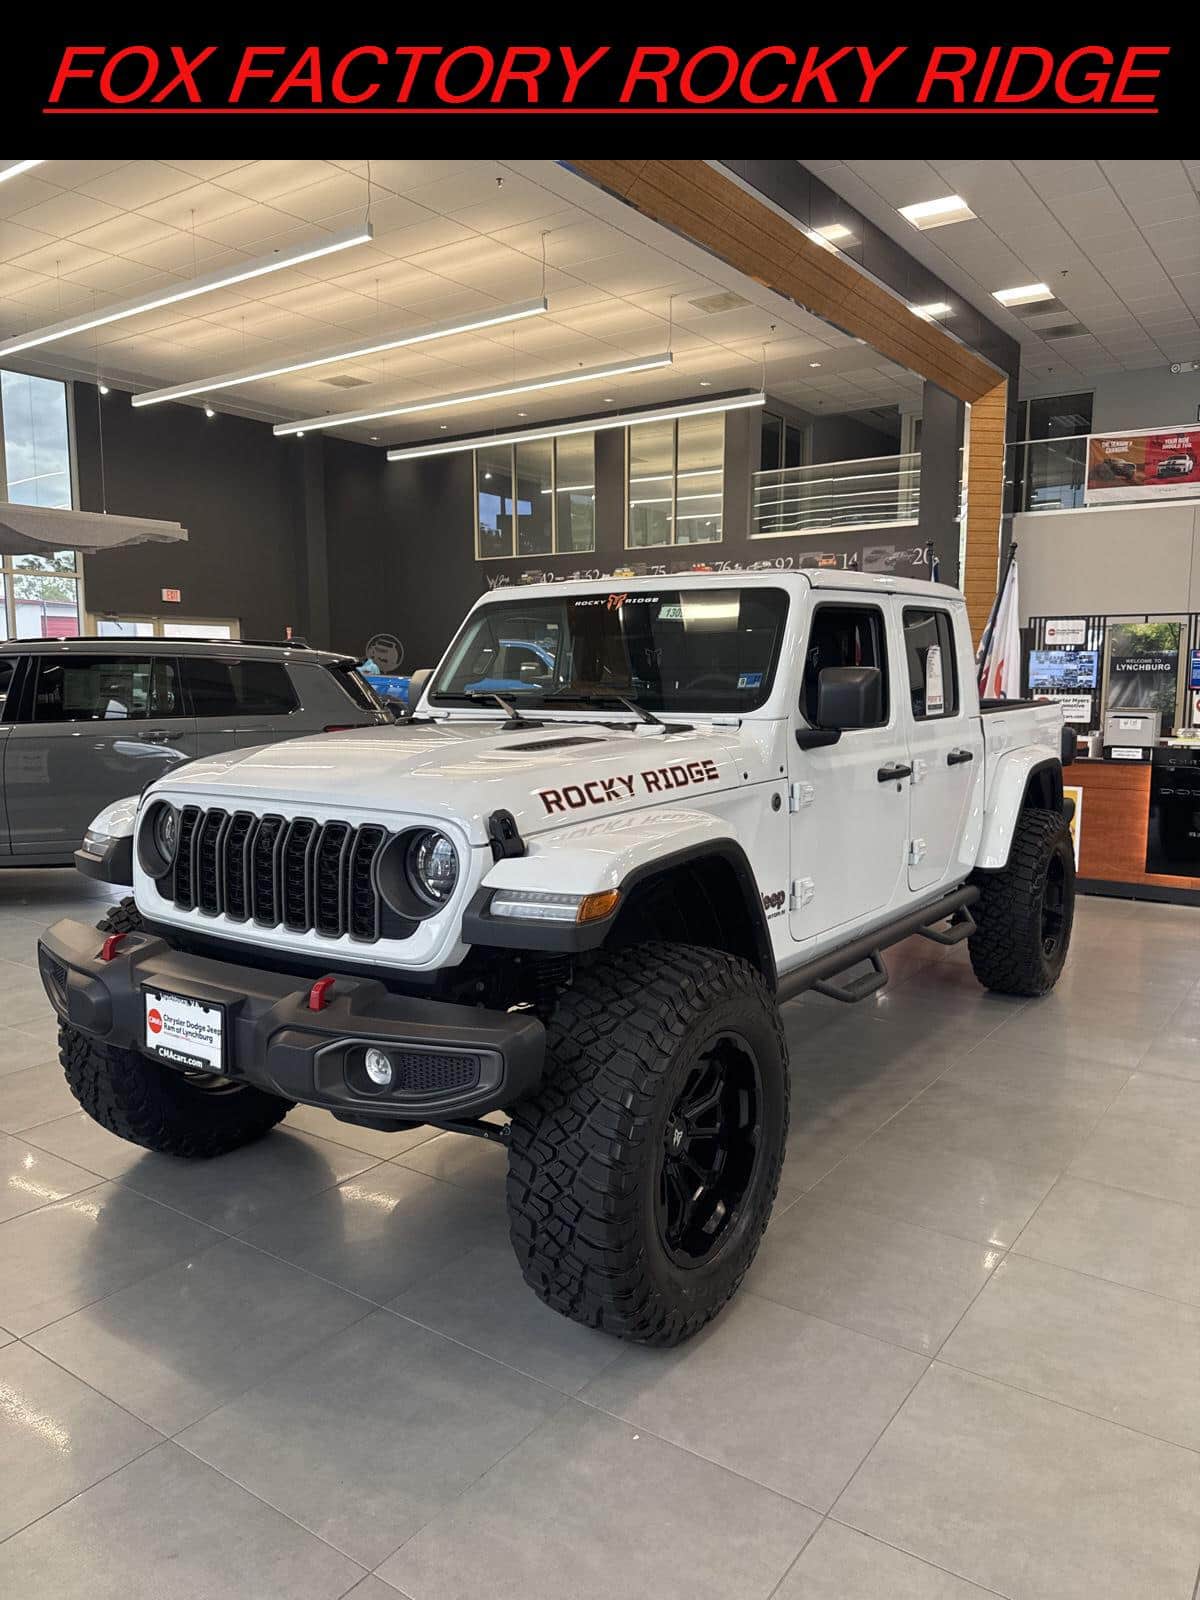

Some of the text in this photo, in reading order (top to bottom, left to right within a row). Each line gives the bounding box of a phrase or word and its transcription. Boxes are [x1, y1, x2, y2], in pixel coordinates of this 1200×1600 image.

[539, 759, 720, 814] ROCKY RIDGE
[163, 1014, 222, 1036] Chrysler Dodge Jeep
[163, 1022, 176, 1032] Ram
[182, 1028, 214, 1044] Lynchburg
[159, 1049, 203, 1068] CMAcars.com
